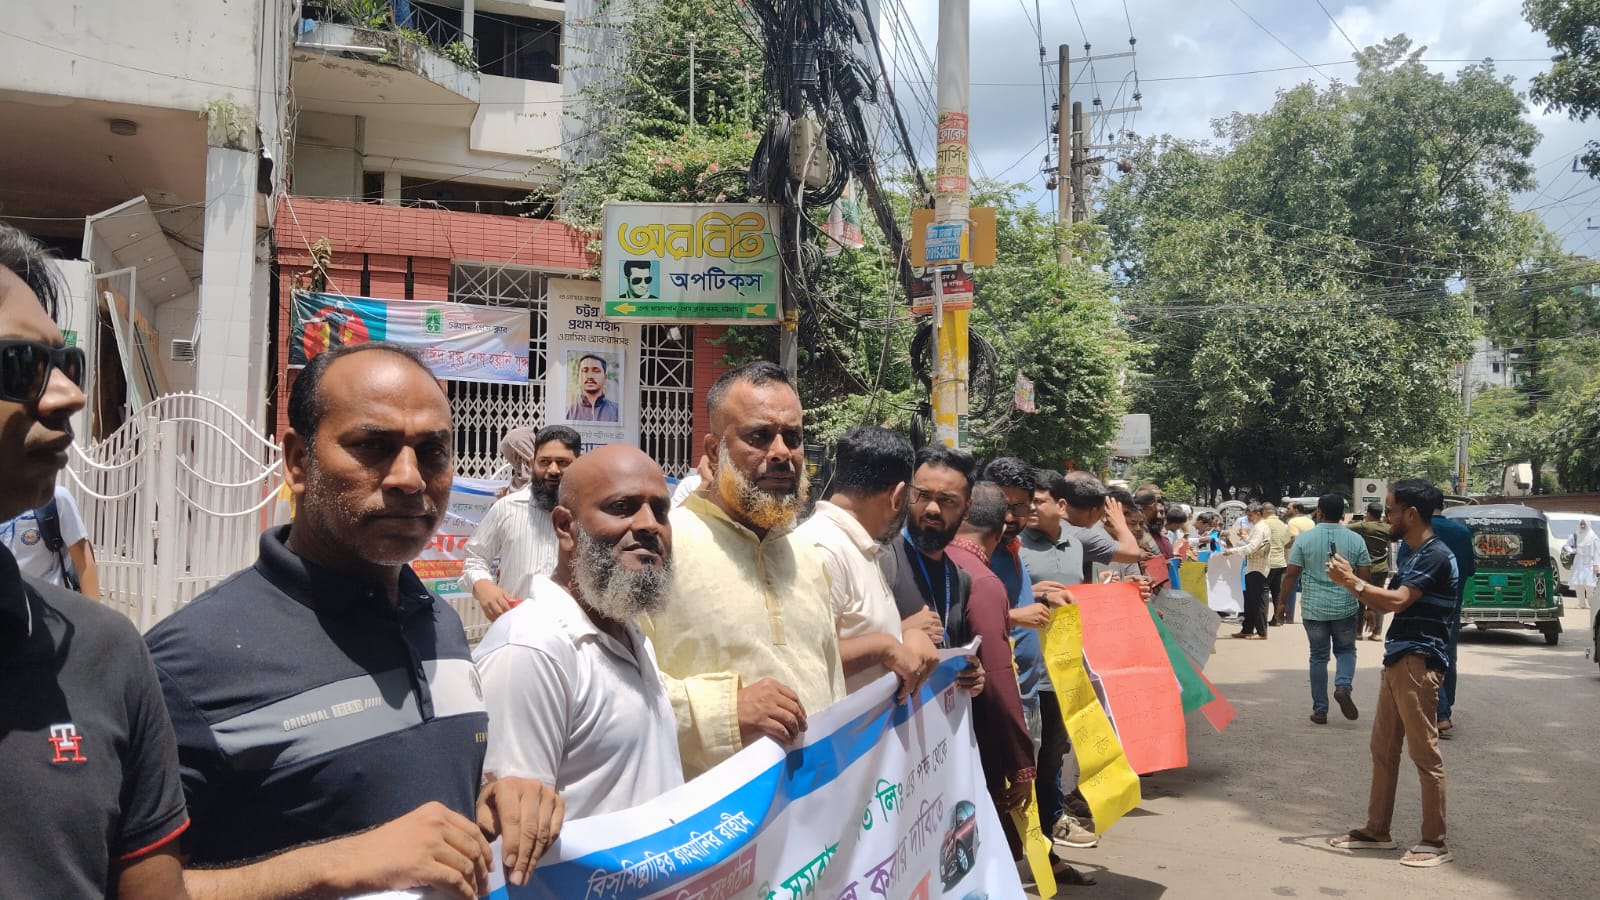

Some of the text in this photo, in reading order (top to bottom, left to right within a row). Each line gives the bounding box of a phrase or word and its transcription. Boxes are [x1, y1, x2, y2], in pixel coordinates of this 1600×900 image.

[617, 211, 766, 261] অরবিট
[568, 319, 593, 330] প্রথম
[467, 351, 486, 368] শেষ
[283, 700, 364, 732] ORIGINAL TREND
